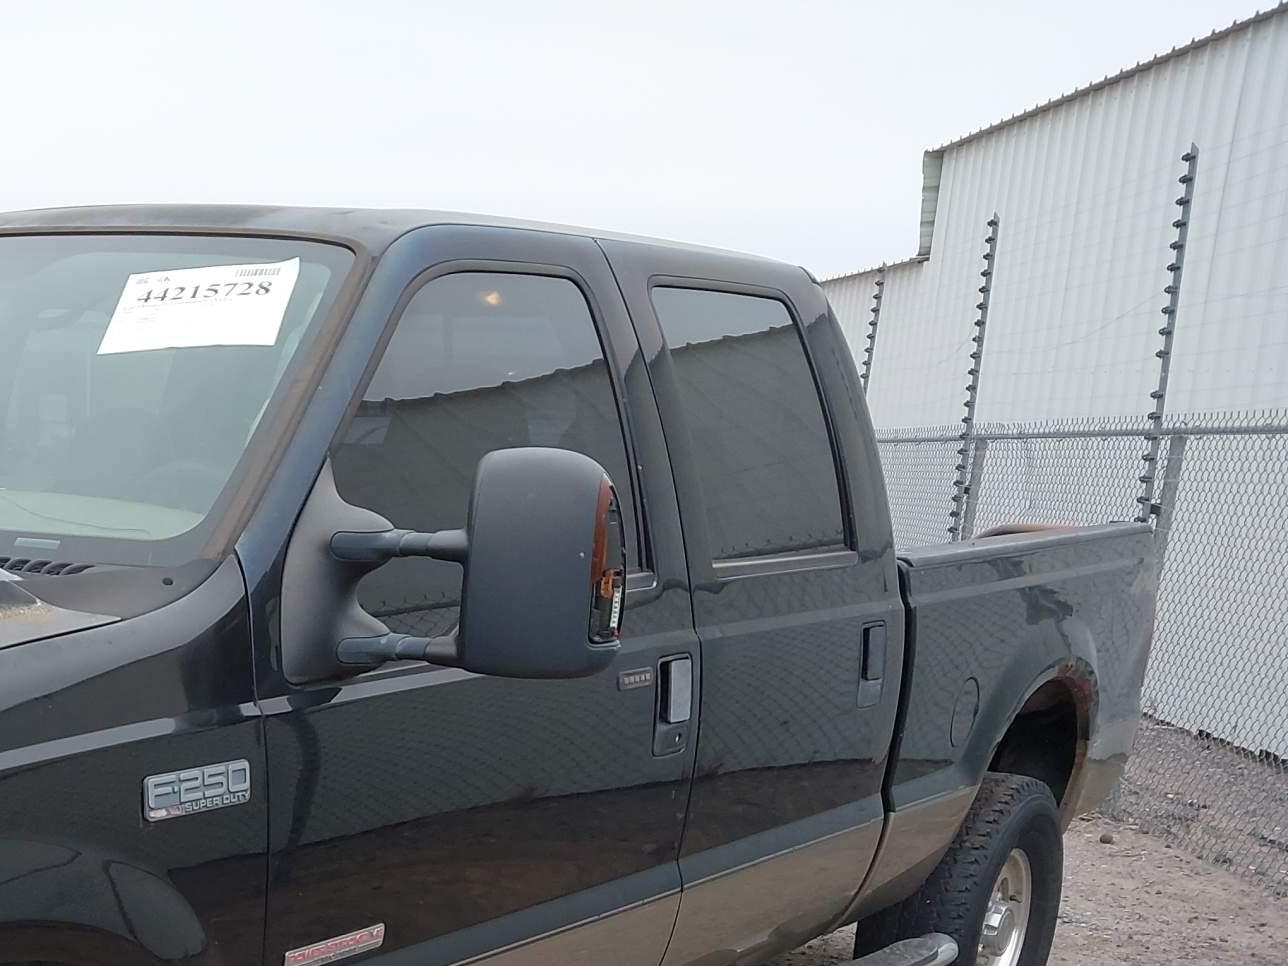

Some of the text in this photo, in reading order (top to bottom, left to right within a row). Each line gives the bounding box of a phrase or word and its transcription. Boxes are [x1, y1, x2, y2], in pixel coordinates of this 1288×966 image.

[137, 280, 273, 303] 44215728
[185, 797, 220, 812] SUPER
[223, 791, 249, 804] DUTY
